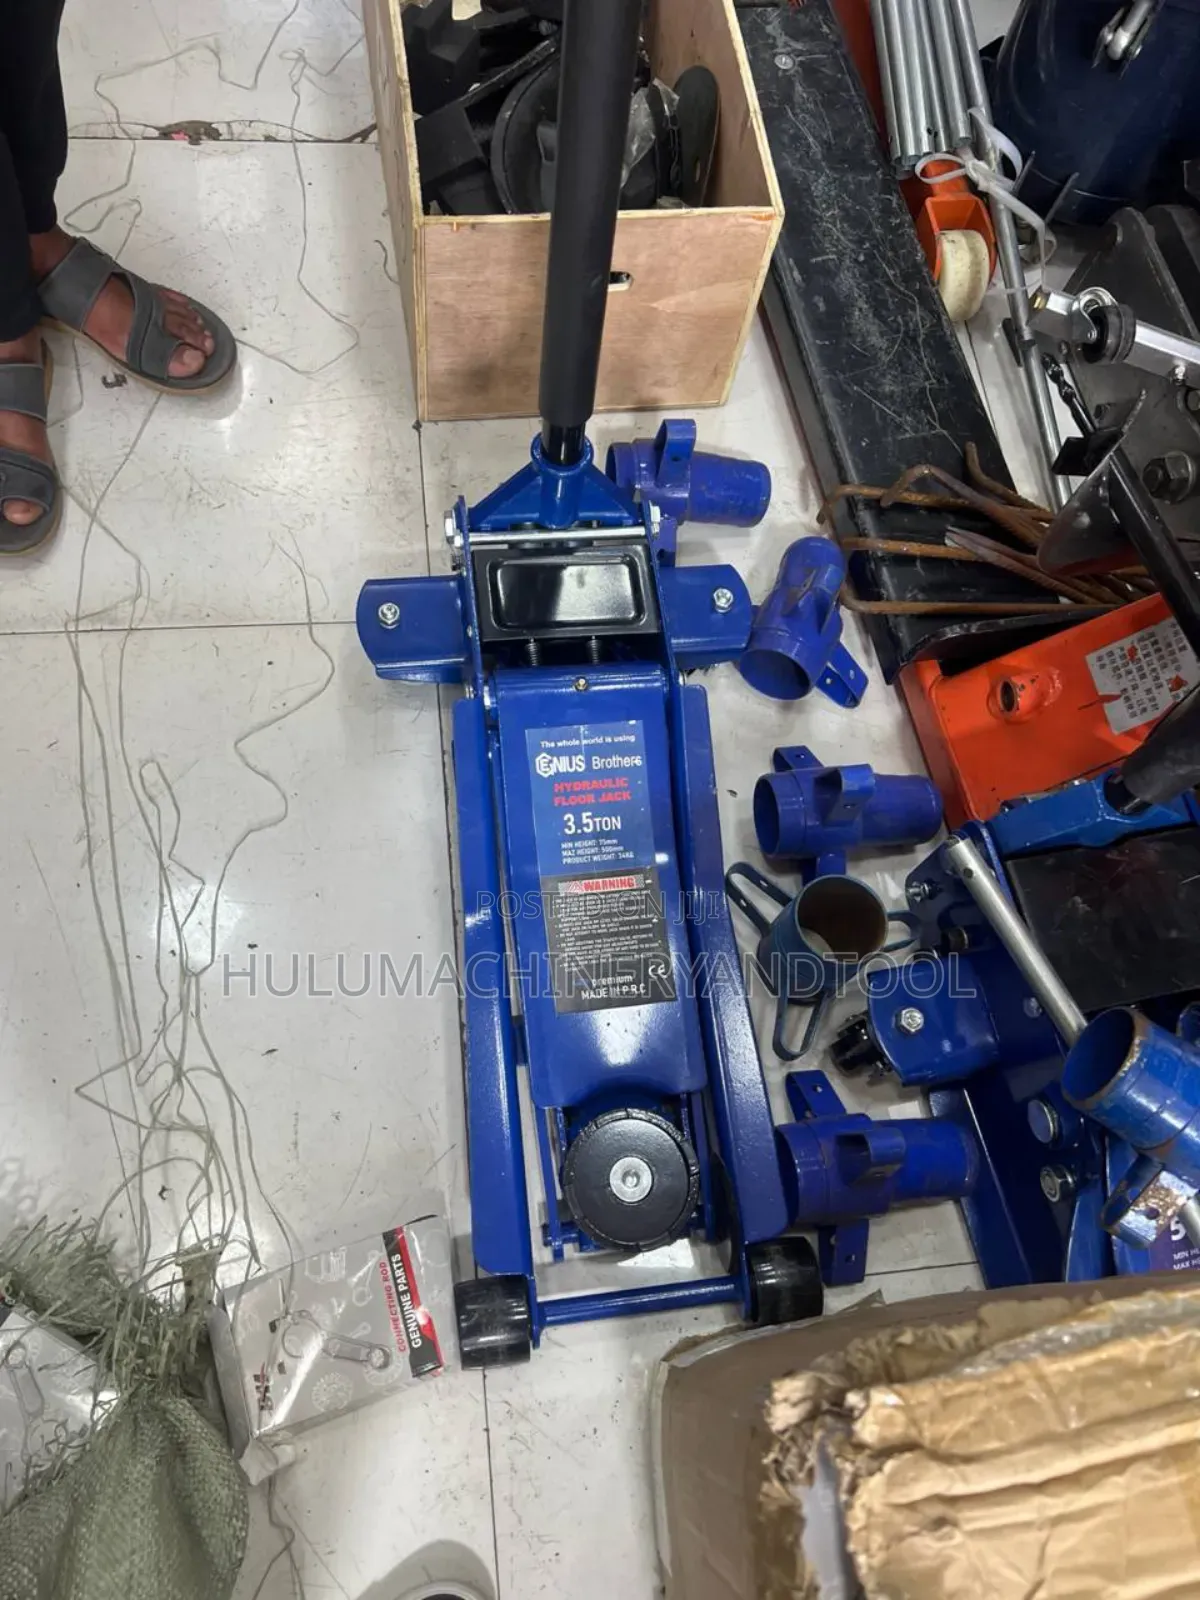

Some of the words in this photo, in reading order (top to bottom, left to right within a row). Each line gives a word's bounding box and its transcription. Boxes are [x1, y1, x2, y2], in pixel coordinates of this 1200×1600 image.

[557, 739, 580, 747] whole
[582, 736, 603, 745] world
[613, 734, 635, 742] using
[591, 755, 643, 769] Brothers
[553, 777, 629, 792] HYDRAULIC
[553, 793, 595, 806] FLOOR
[599, 791, 631, 803] JACK
[562, 856, 591, 865] PRODUCT
[583, 877, 636, 891] WARNING
[591, 975, 633, 988] premium
[581, 987, 609, 1000] MADE
[609, 986, 621, 998] IN
[379, 1262, 390, 1282] ROD
[391, 1253, 408, 1292] PARTS
[385, 1285, 406, 1352] CONNECTING
[401, 1292, 422, 1348] GENUINE
